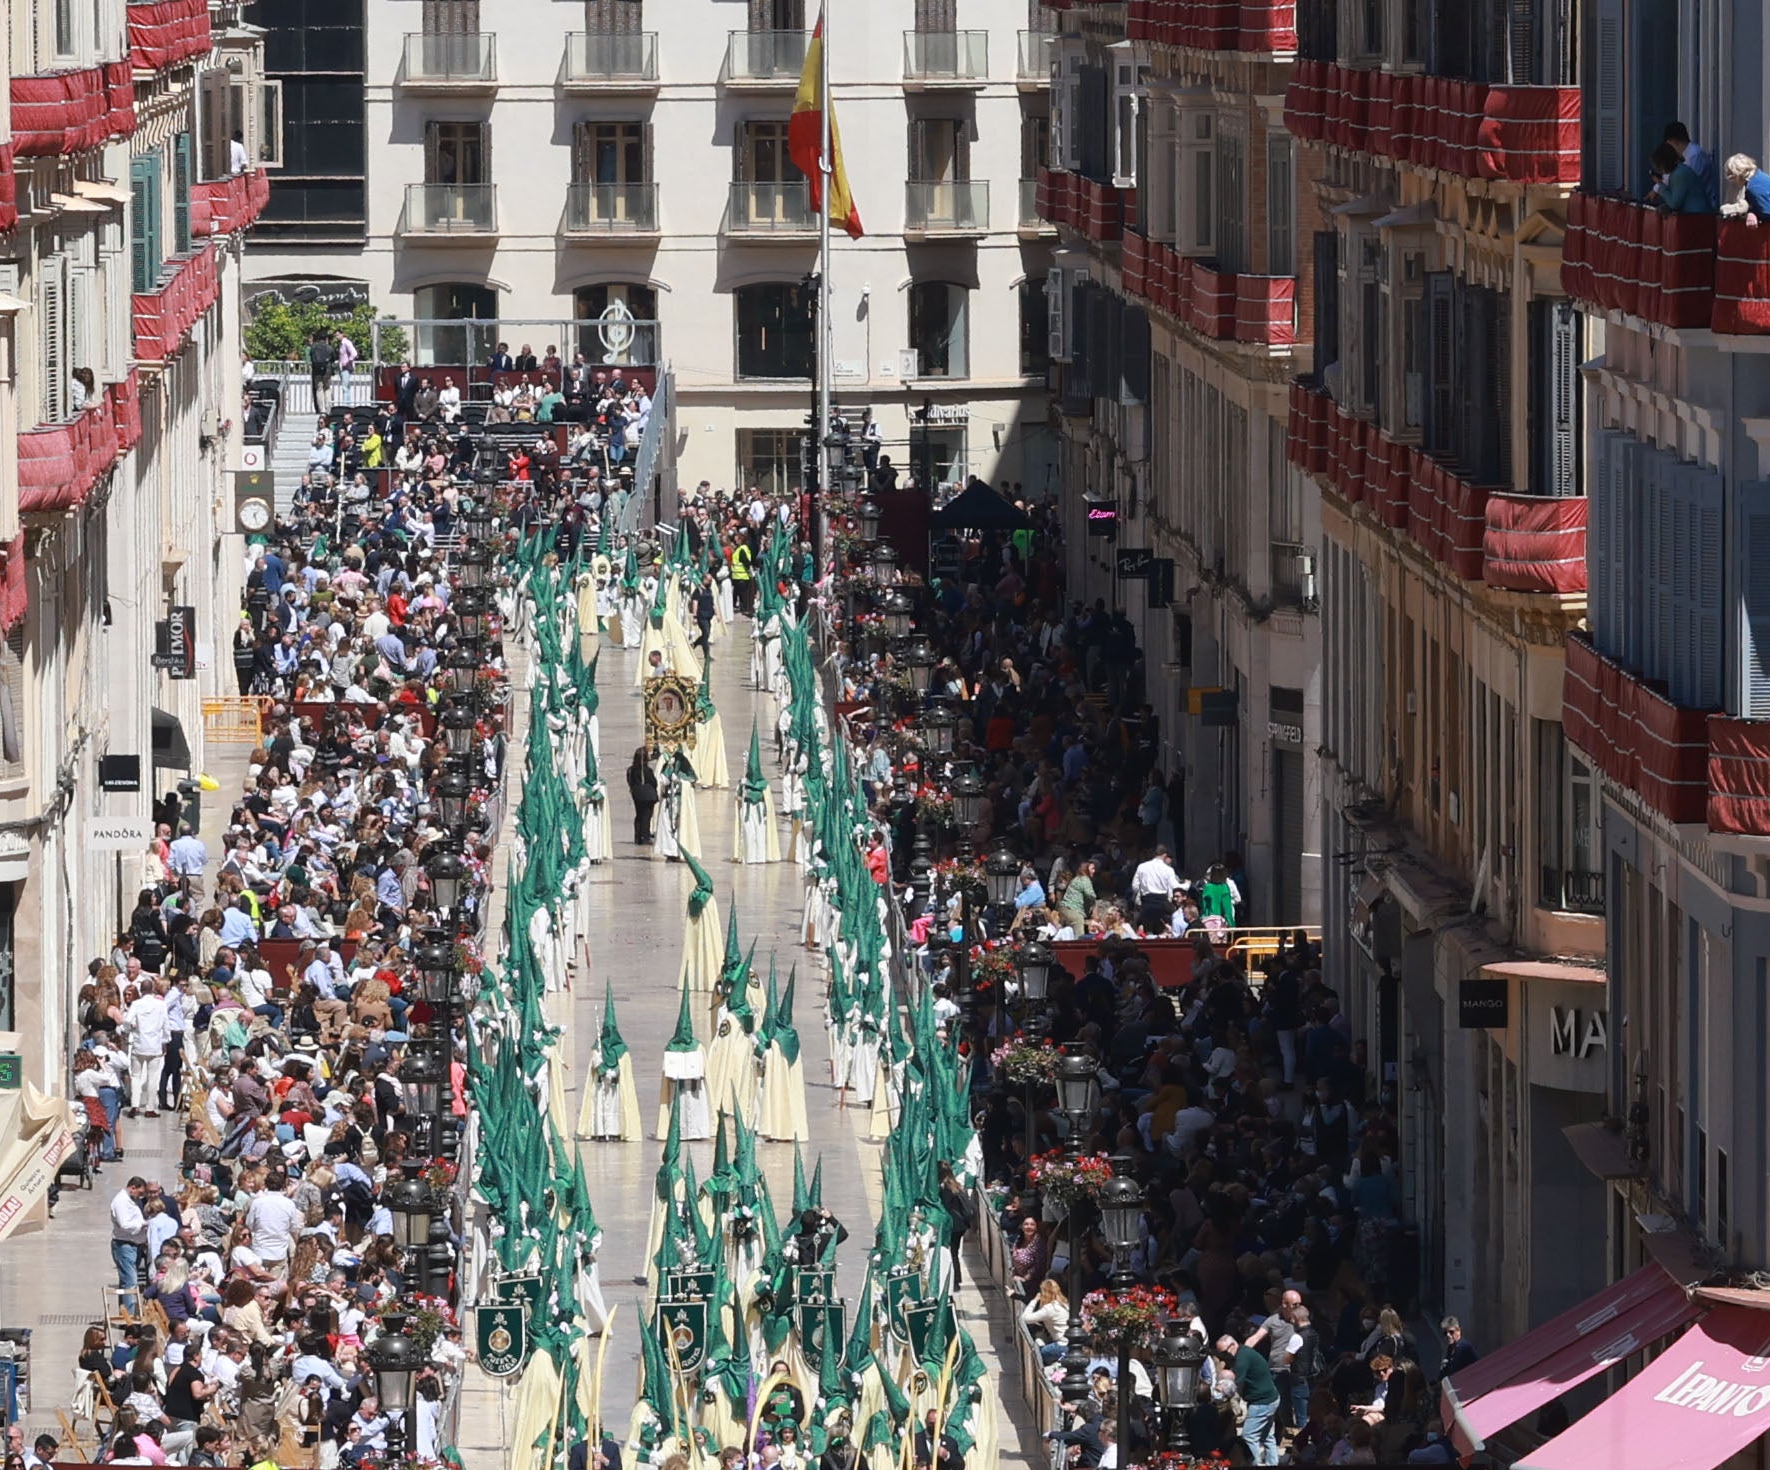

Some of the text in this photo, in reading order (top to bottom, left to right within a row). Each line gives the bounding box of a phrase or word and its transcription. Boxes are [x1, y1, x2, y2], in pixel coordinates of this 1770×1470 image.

[1089, 509, 1116, 519] Etam
[171, 611, 184, 676] PIMOR
[1463, 1000, 1504, 1009] MANGO
